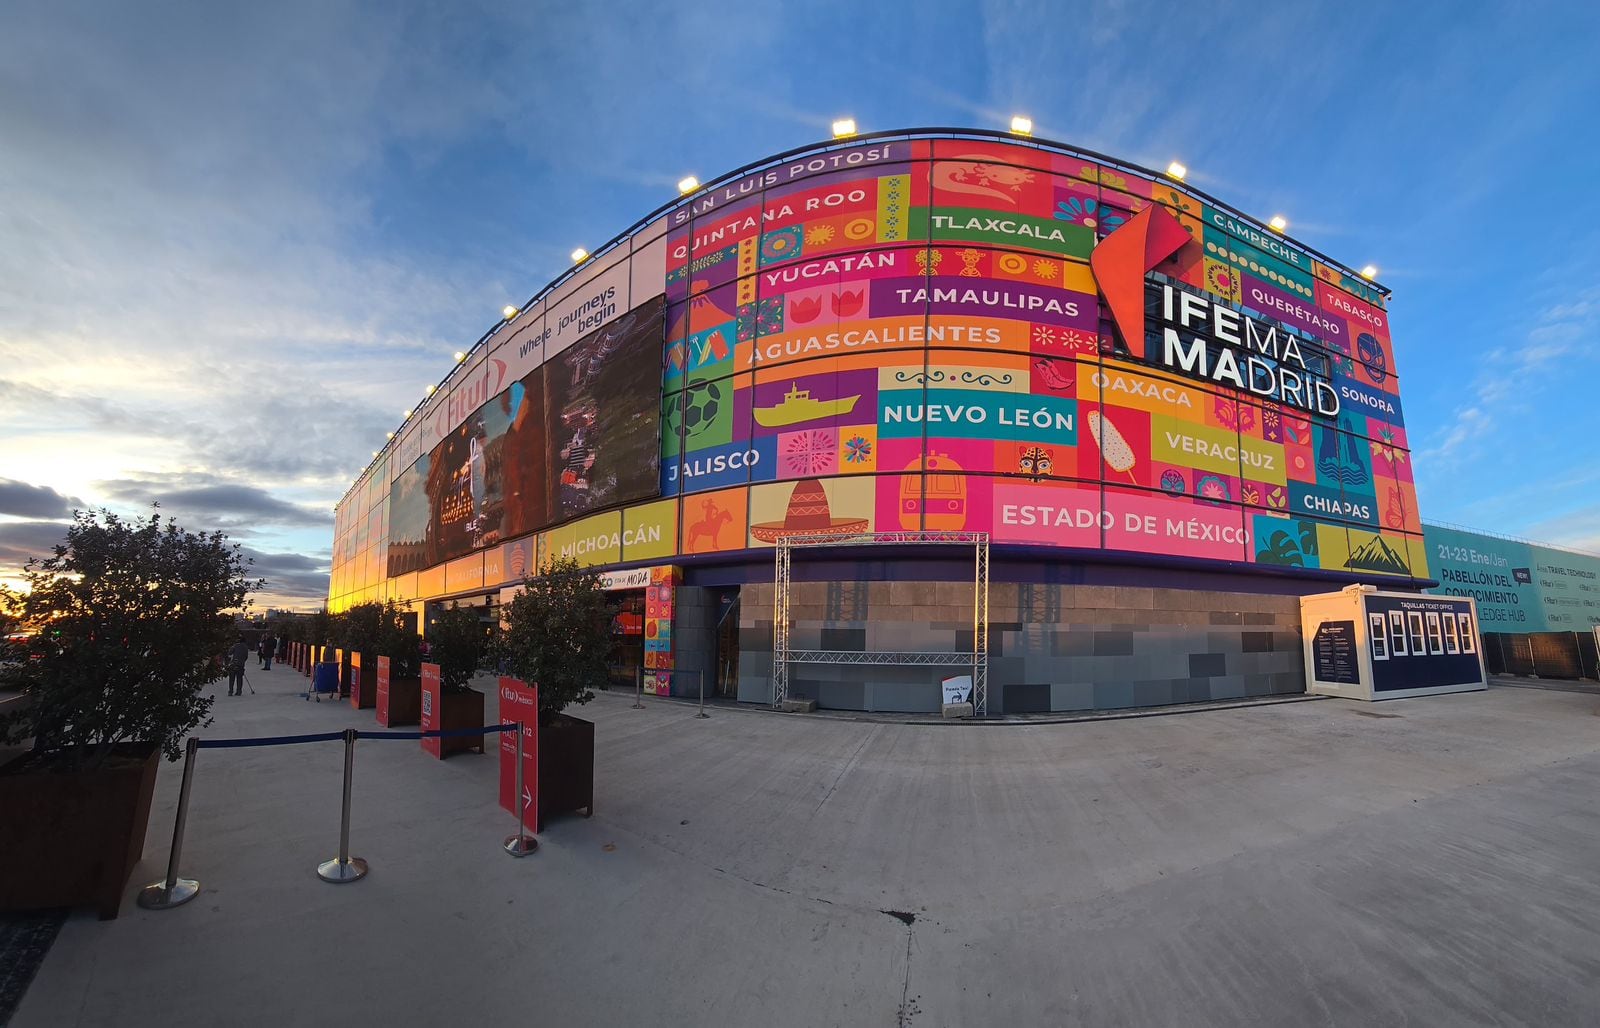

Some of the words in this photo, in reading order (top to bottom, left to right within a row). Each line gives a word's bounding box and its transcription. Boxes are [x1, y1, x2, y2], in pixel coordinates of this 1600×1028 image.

[675, 196, 714, 225] SAN
[725, 171, 777, 200] LUIS
[789, 144, 890, 175] POTOSÍ
[673, 205, 793, 260] QUINTANA
[805, 189, 866, 212] ROO
[931, 215, 1066, 244] TLAXCALA
[1213, 213, 1299, 264] CAMPECHE
[766, 251, 895, 288] YUCATÁN
[578, 303, 616, 334] begin
[896, 288, 1079, 317] TAMAULIPAS
[1251, 287, 1341, 335] QUERÉTARO
[1326, 293, 1383, 328] TABASCO
[519, 327, 552, 358] Where
[558, 286, 615, 336] journeys
[1163, 284, 1307, 369] IFEMA
[747, 326, 1001, 365] AGUASCALIENTES
[1091, 371, 1192, 408] OAXACA
[1164, 328, 1341, 418] MADRID
[883, 404, 987, 425] NUEVO
[998, 407, 1074, 432] LEÓN
[1341, 386, 1395, 415] SONORA
[668, 449, 760, 482] JALISCO
[1165, 431, 1275, 471] VERACRUZ
[1303, 494, 1370, 519] CHIAPAS
[561, 524, 661, 559] MICHOACÁN
[1001, 504, 1114, 531] ESTADO
[1125, 514, 1157, 536] DE
[1166, 518, 1250, 545] MÉXICO
[1438, 544, 1468, 561] 21-23
[1470, 550, 1508, 567] Ene/Jan
[1442, 568, 1492, 586] PABELLÓN
[1495, 574, 1512, 587] DEL
[1445, 587, 1519, 605] CONOCIMIENTO
[1478, 607, 1506, 621] LEDGE
[1509, 610, 1526, 622] HUB
